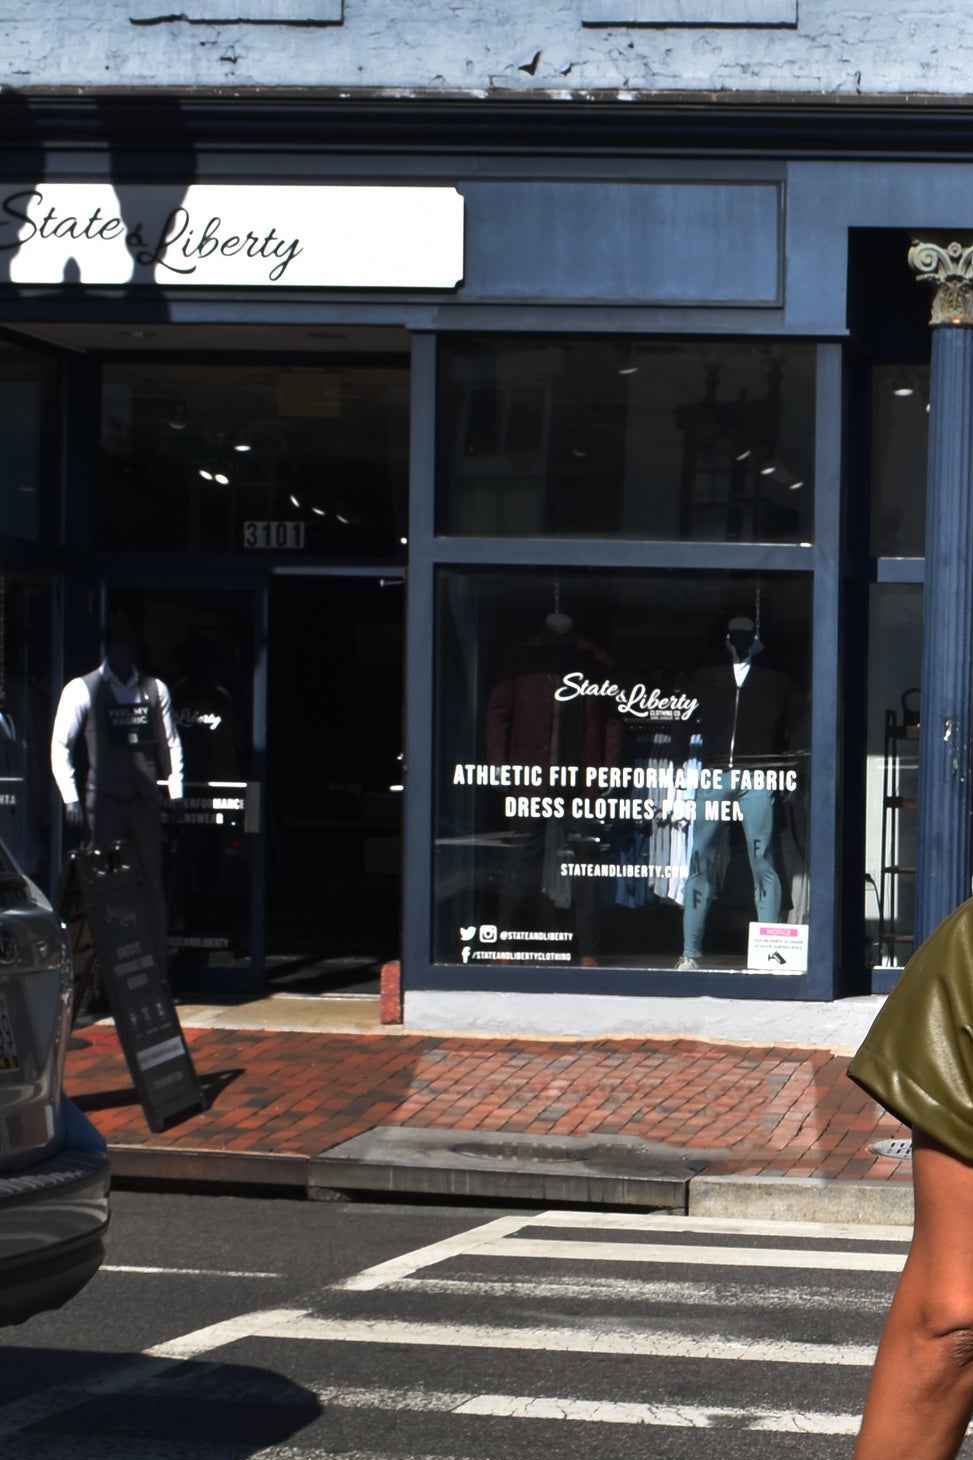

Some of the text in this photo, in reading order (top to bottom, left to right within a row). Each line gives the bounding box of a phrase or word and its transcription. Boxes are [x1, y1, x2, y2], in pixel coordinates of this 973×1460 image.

[0, 190, 127, 251] State
[137, 206, 304, 281] Liberty
[246, 522, 301, 546] 3101
[554, 671, 620, 702] State
[617, 683, 700, 721] Liberty
[133, 705, 149, 716] MY
[452, 764, 797, 792] ATHLETIC FIT PERFORMANCE FABRIC
[506, 796, 744, 822] DRESS CLOTHES FOR MEN
[560, 863, 689, 879] STATEANDLIBERTY.COM
[499, 930, 573, 941] @STATEANDLIBERTY
[471, 950, 572, 961] /STATEANDLIBERTYCLOTHING
